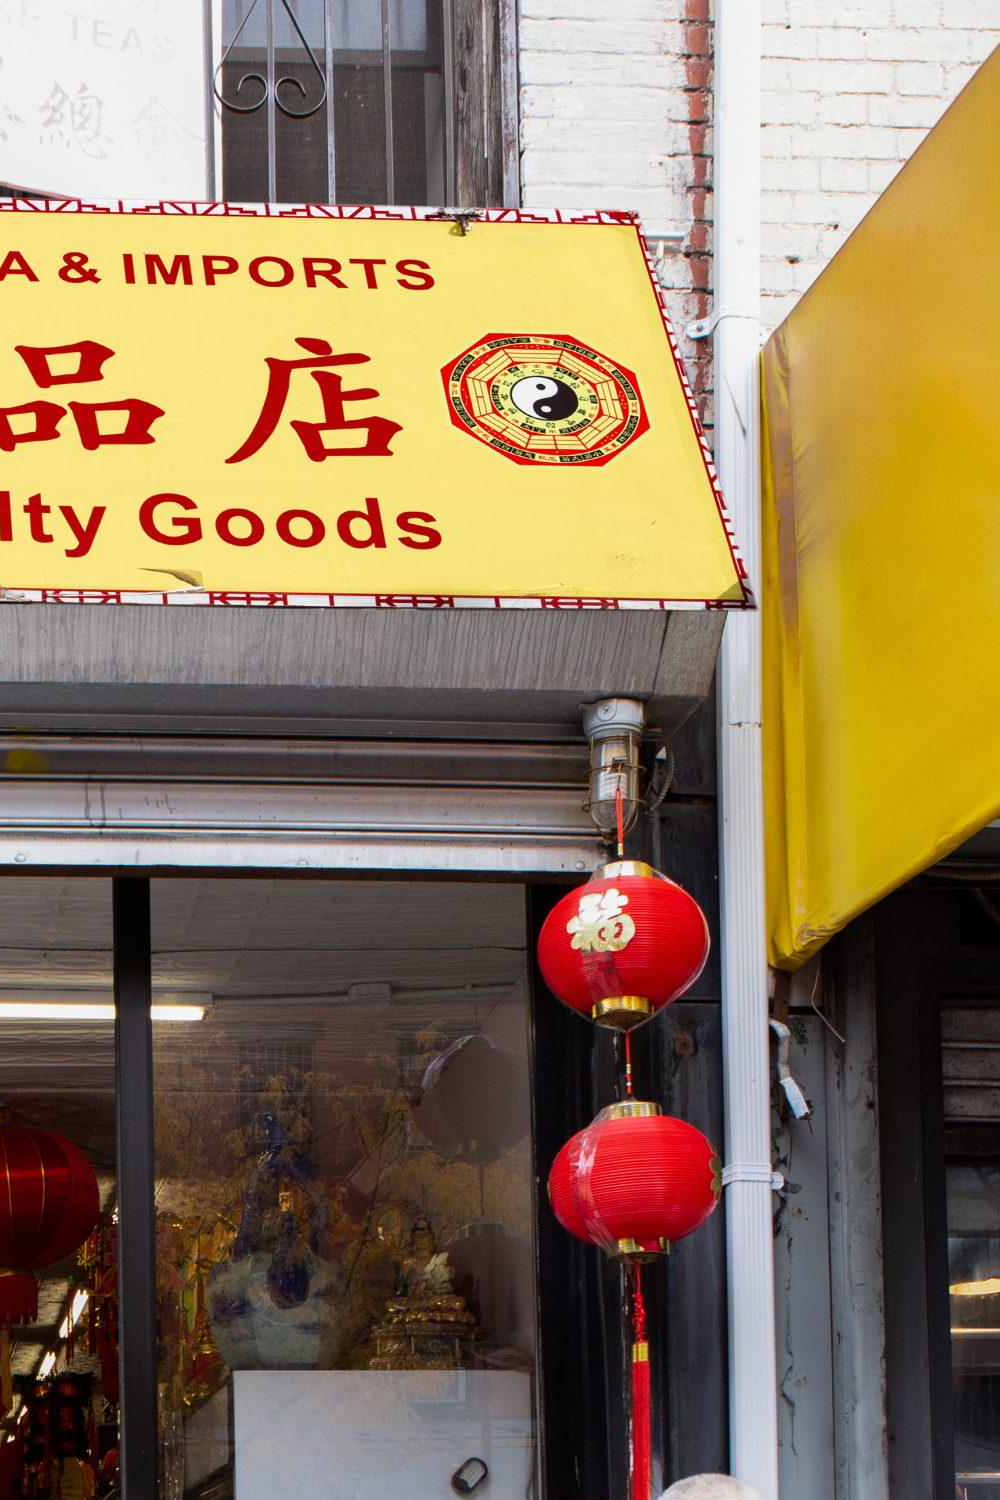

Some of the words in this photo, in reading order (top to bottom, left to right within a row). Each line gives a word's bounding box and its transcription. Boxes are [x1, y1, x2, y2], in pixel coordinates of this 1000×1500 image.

[65, 10, 174, 63] TEAS
[59, 252, 102, 284] &
[123, 254, 435, 291] IMPORTS
[139, 494, 442, 550] Goods
